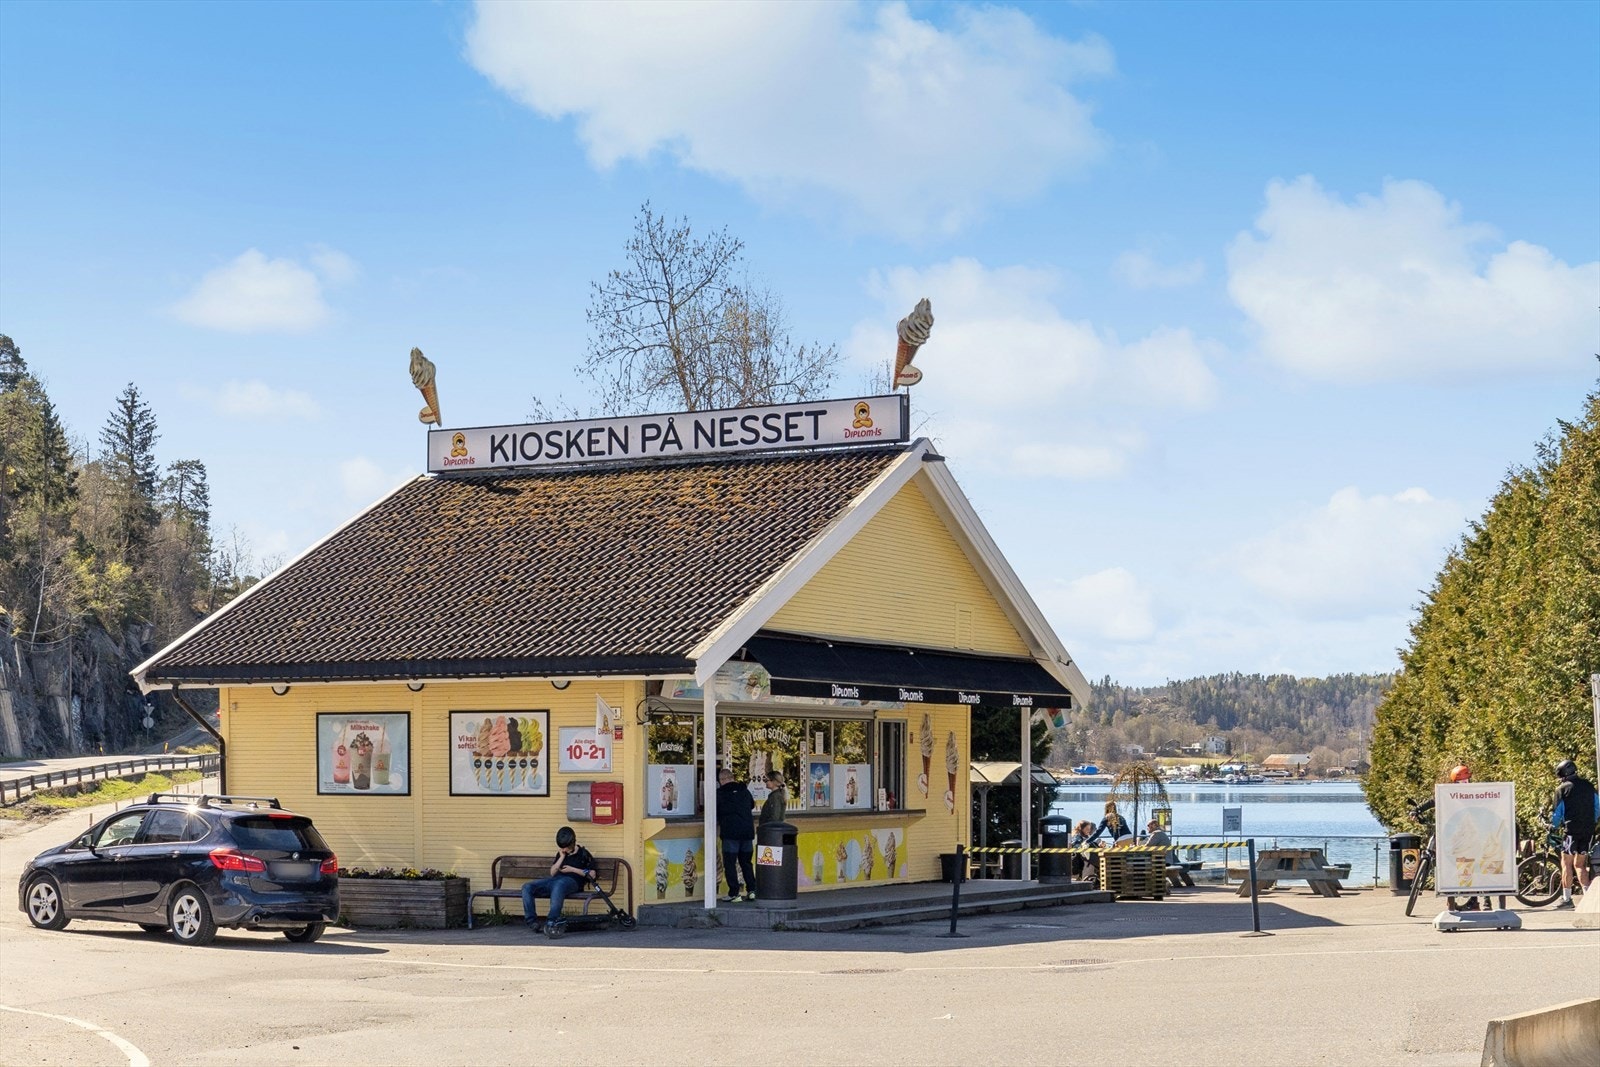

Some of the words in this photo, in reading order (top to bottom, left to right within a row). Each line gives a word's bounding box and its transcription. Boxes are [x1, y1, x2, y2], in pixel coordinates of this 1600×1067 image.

[490, 424, 630, 463] KIOSKEN
[641, 416, 683, 453] PÅ
[694, 409, 827, 449] NESSET
[752, 727, 767, 741] kan
[768, 726, 791, 747] softis!
[566, 744, 606, 760] 10-21
[657, 741, 684, 753] Milkshake
[1475, 791, 1501, 799] softis!
